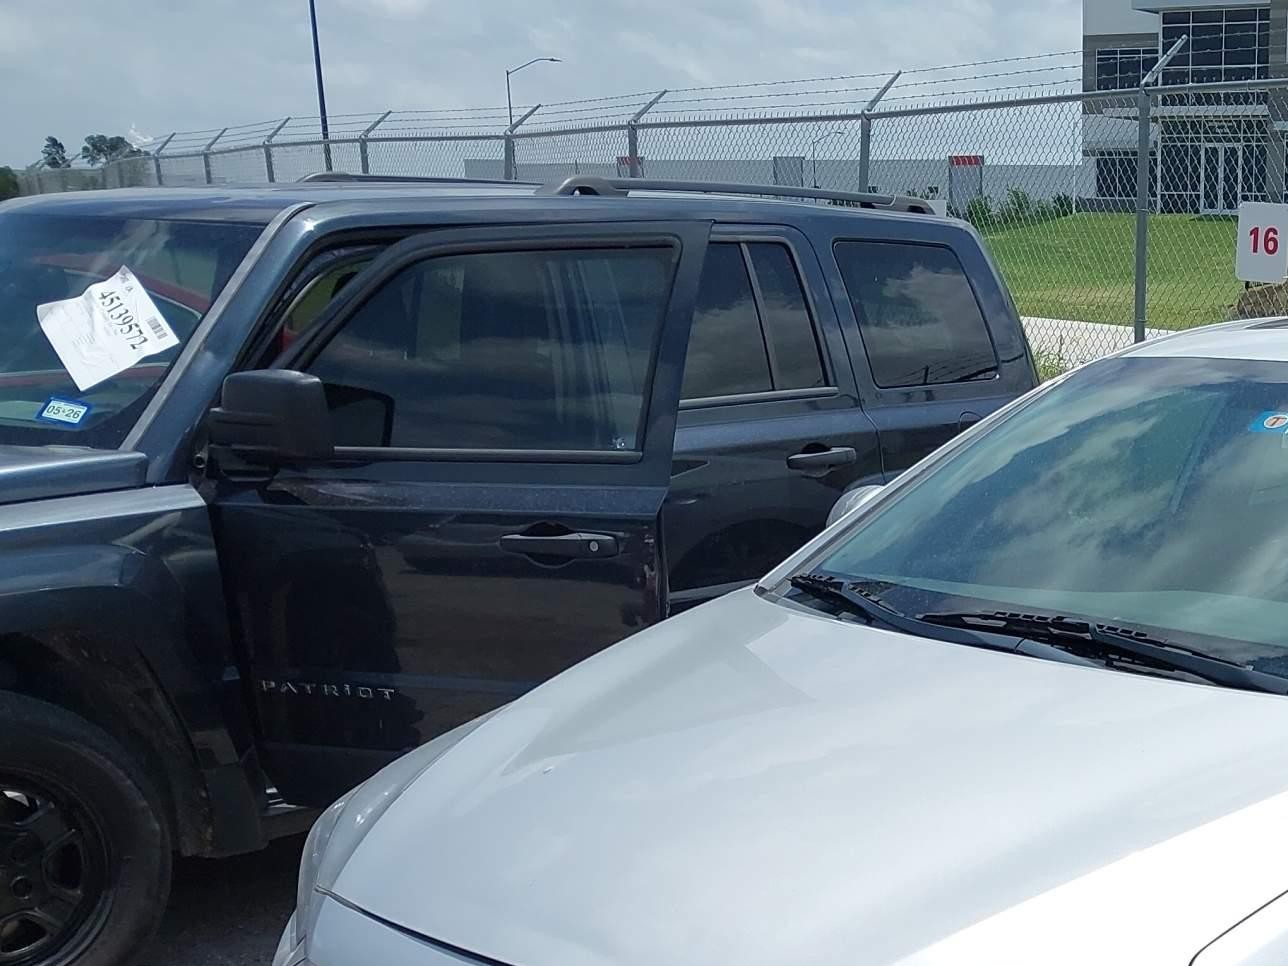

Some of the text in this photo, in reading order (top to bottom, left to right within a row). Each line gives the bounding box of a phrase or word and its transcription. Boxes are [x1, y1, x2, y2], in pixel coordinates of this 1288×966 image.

[1248, 224, 1280, 256] 16
[98, 290, 149, 350] 45139572
[258, 679, 396, 701] PATRIOT
